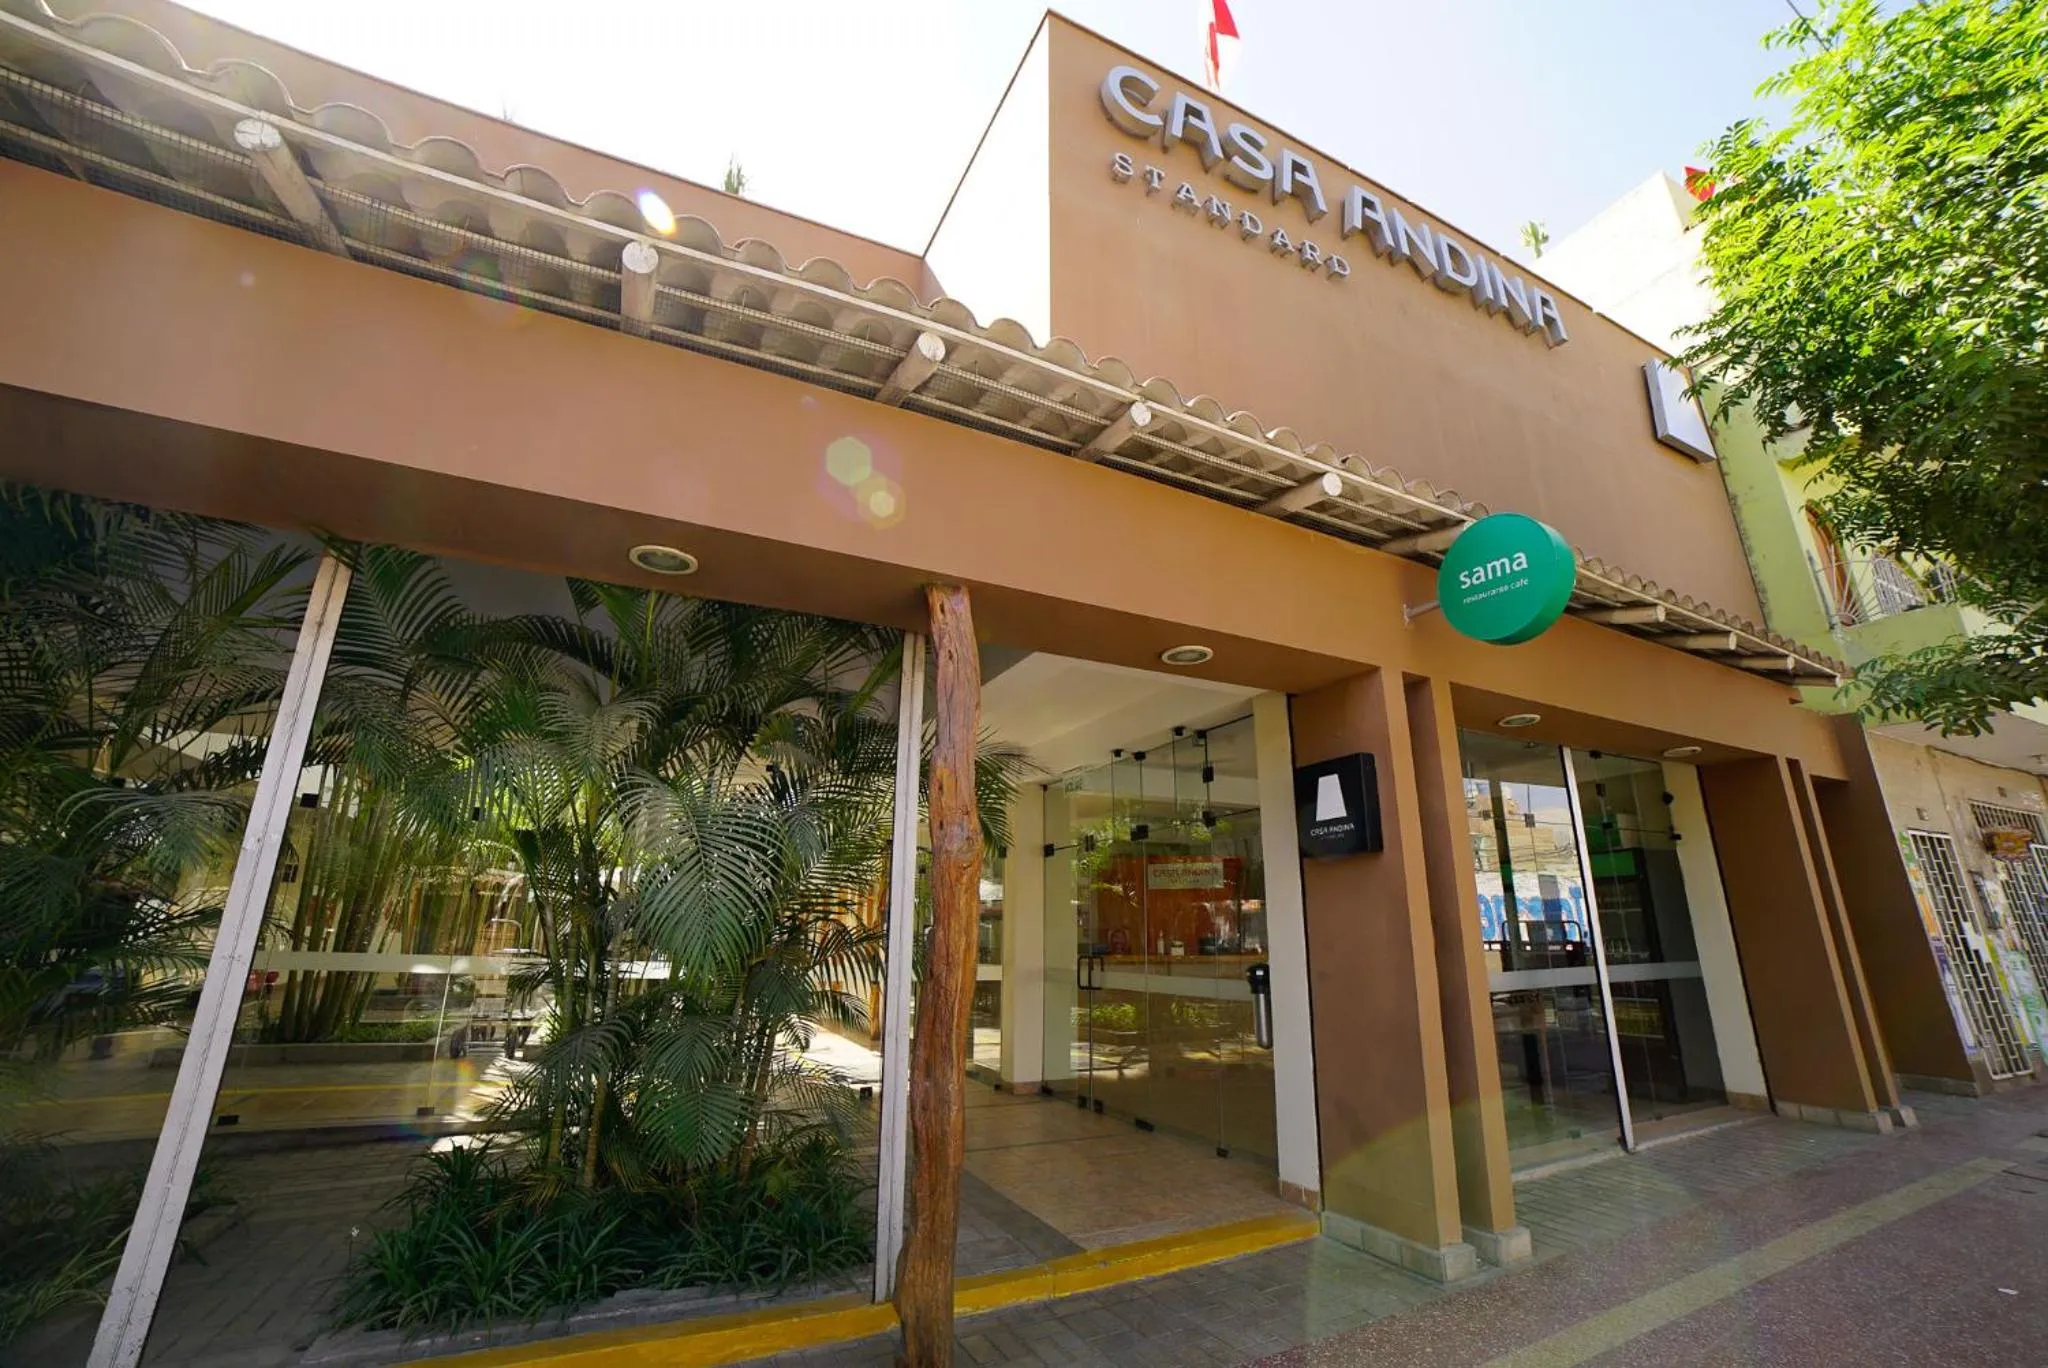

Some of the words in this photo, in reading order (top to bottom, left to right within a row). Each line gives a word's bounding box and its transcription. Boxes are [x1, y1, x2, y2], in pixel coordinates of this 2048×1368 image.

[1099, 65, 1328, 224] CASA
[1341, 184, 1569, 348] ANDINA
[1111, 152, 1351, 281] STANDARD
[1459, 551, 1529, 589] sama
